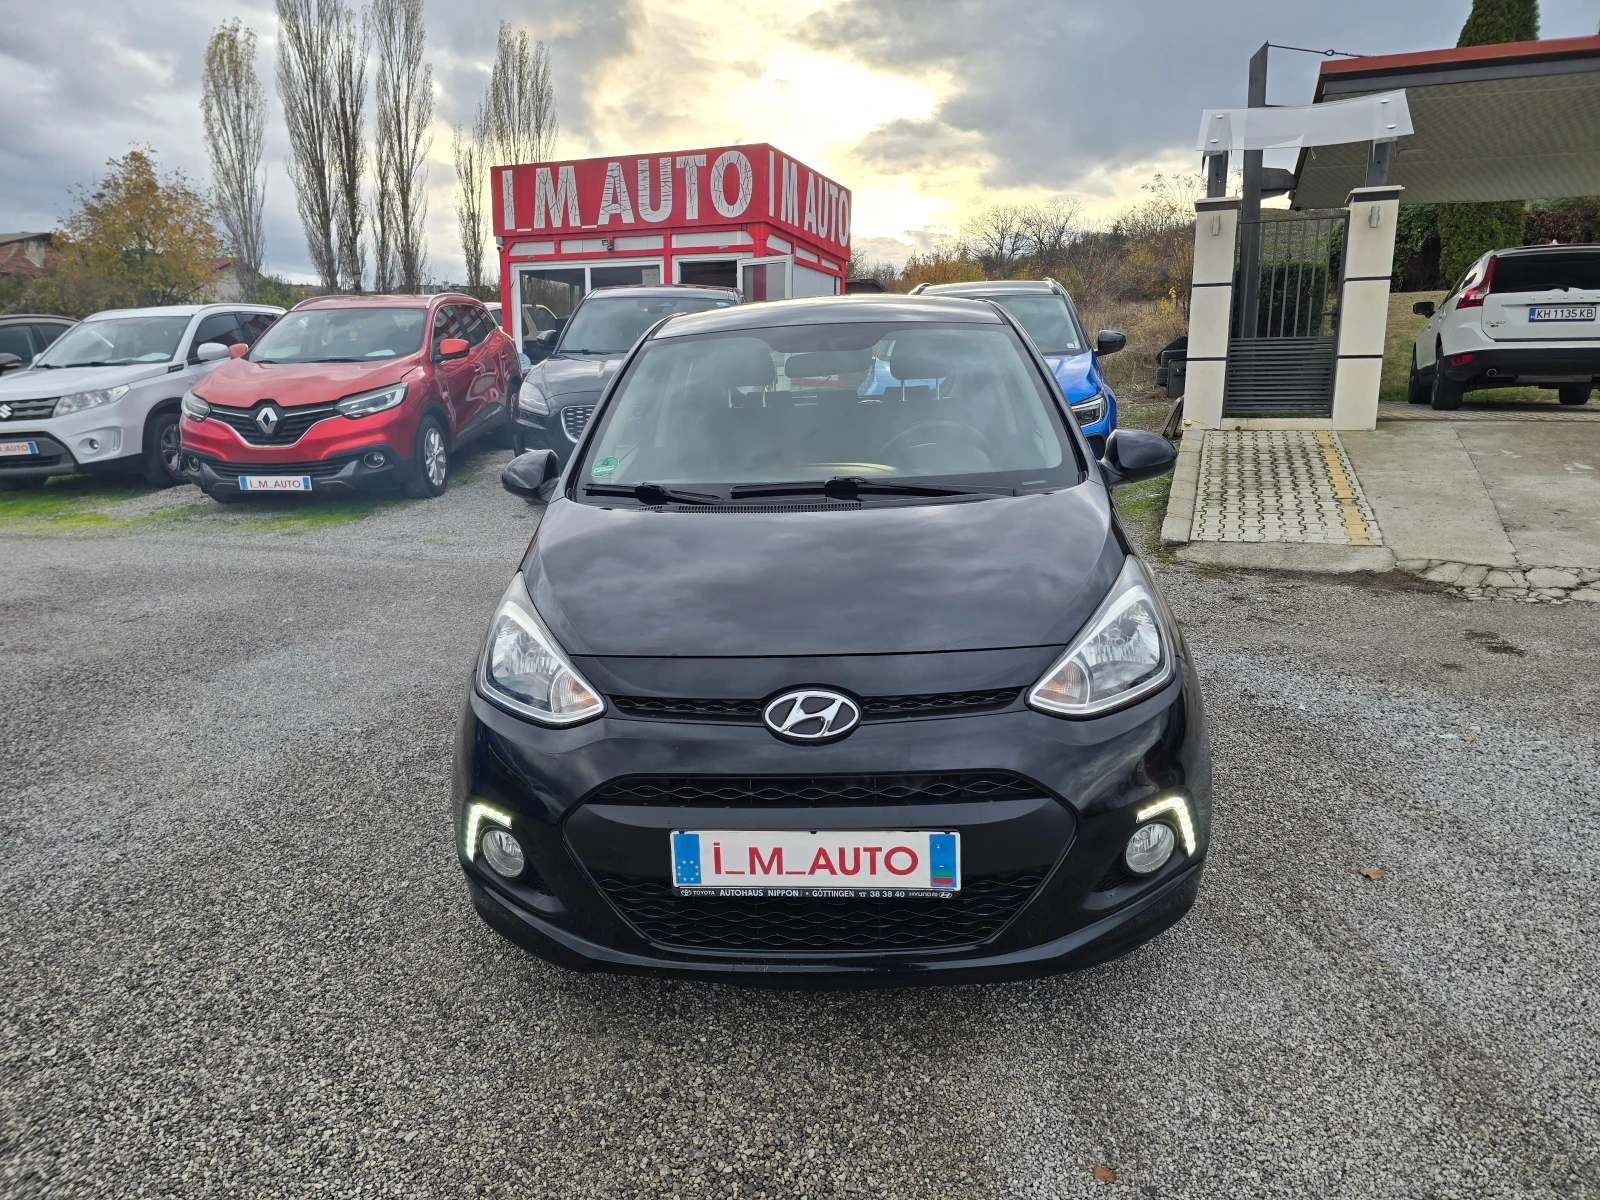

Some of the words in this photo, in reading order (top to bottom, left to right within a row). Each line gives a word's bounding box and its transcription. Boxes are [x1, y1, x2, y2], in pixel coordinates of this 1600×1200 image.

[768, 150, 775, 218] I
[780, 157, 799, 227] M
[803, 171, 850, 248] AUTO
[1536, 309, 1551, 319] KH
[1553, 309, 1578, 318] 1135
[1579, 308, 1594, 318] KB
[720, 889, 763, 897] AUTOHAUS
[767, 889, 799, 898] NIPPON
[812, 888, 855, 898] GÖTTINGEN
[870, 890, 881, 898] 38
[882, 890, 893, 898] 38
[894, 890, 906, 898] 40
